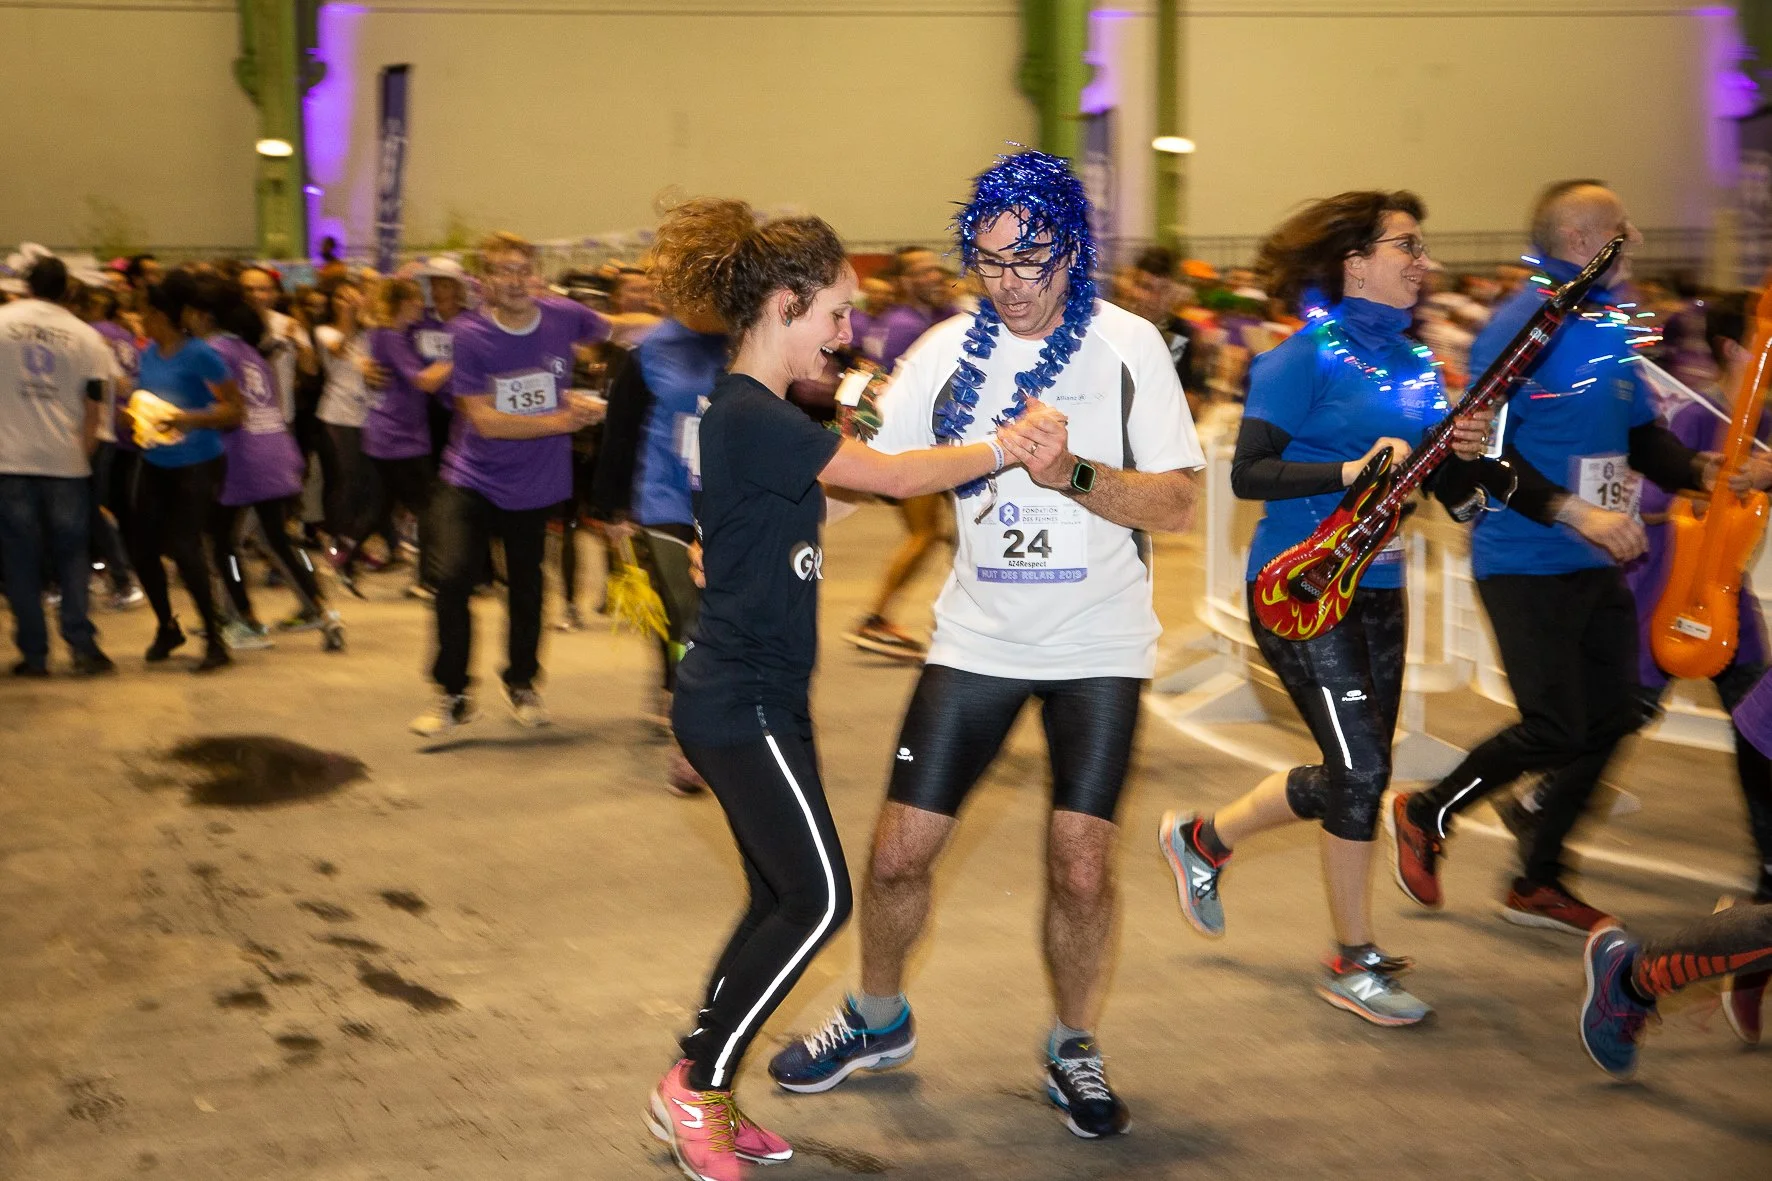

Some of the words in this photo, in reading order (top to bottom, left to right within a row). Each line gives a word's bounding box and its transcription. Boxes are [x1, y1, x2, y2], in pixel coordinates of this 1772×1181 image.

[508, 390, 546, 409] 135
[1003, 529, 1052, 558] 24
[981, 570, 999, 579] NUIT
[1001, 570, 1019, 580] DES
[1021, 570, 1056, 580] RELAIS
[1059, 570, 1082, 580] 2019
